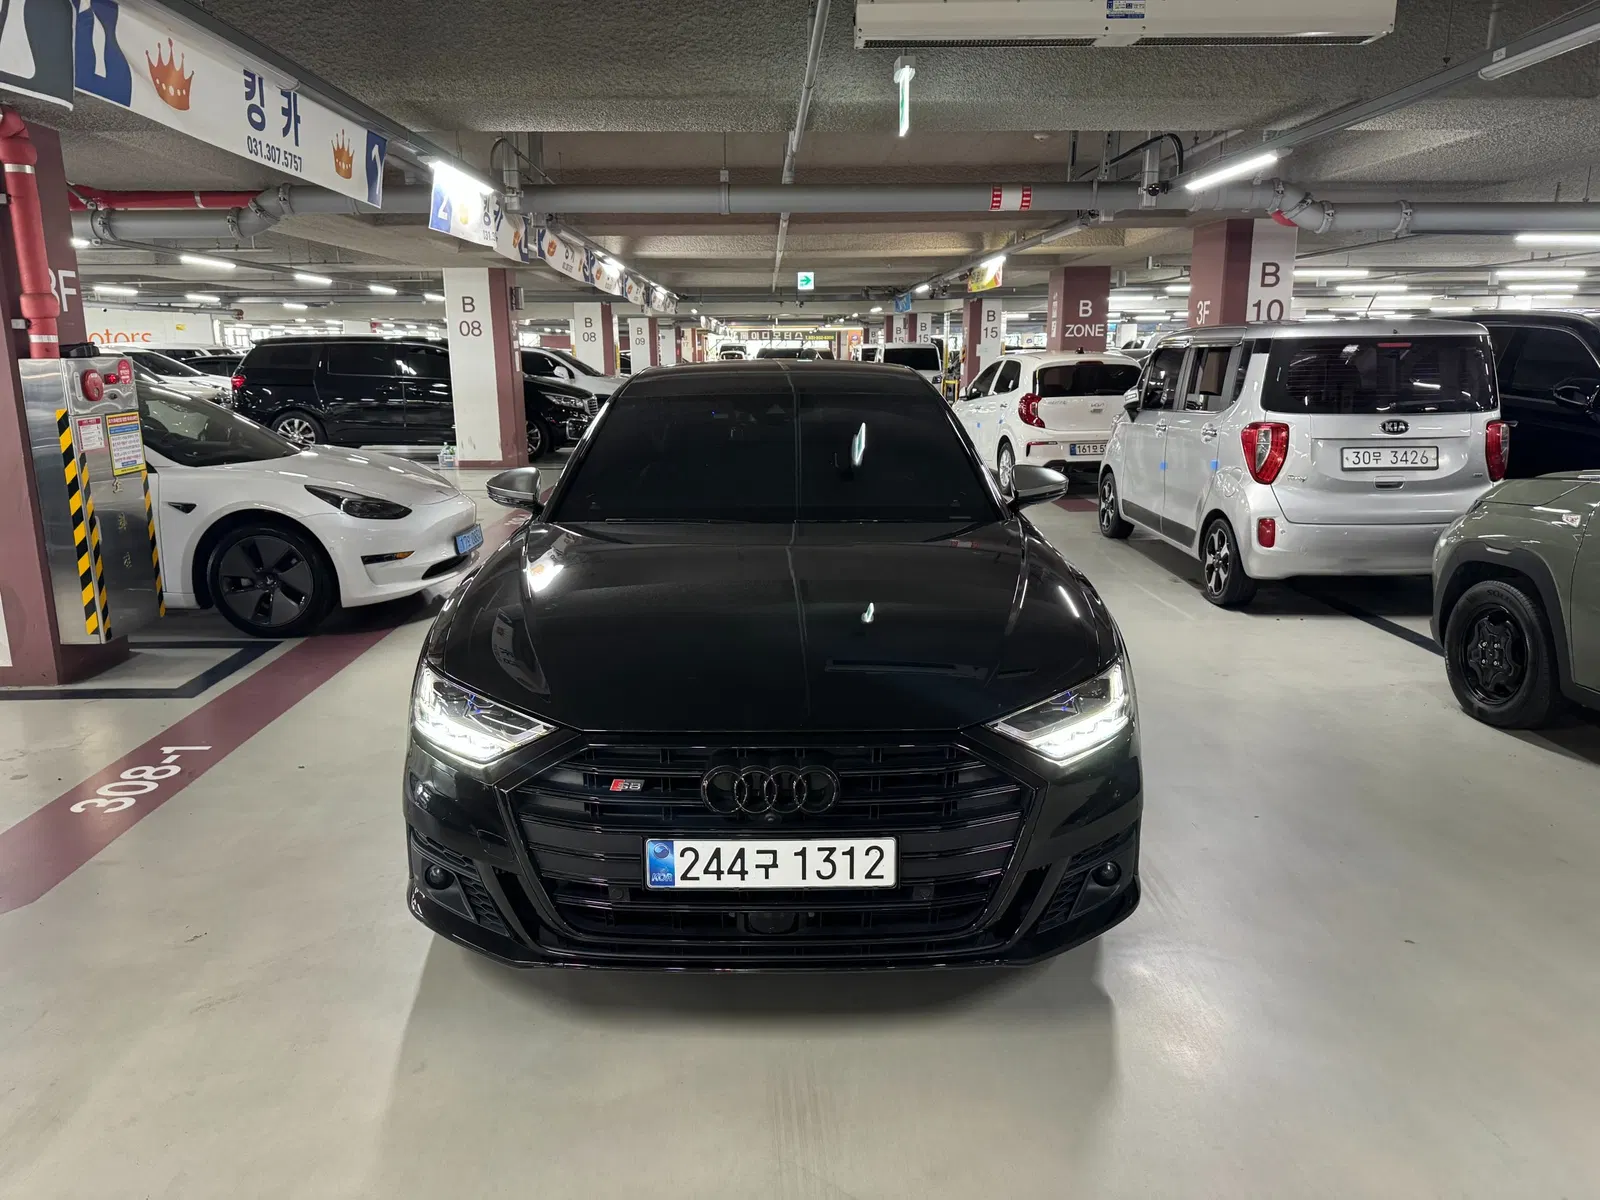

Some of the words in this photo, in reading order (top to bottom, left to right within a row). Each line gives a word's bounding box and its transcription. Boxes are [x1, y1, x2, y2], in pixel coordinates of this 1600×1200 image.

[247, 135, 302, 173] 031.307.5757
[1260, 262, 1281, 288] B
[462, 296, 475, 313] B
[1079, 300, 1092, 317] B
[1252, 299, 1284, 321] 10
[986, 310, 996, 322] B
[1196, 300, 1211, 325] 3F
[459, 320, 482, 337] 08
[584, 317, 593, 328] B
[920, 322, 927, 331] B
[582, 331, 597, 343] 08
[636, 327, 643, 336] B
[983, 326, 998, 339] 15
[1065, 323, 1105, 338] ZONE
[635, 338, 646, 346] 09
[918, 334, 929, 343] 15
[1385, 421, 1406, 432] KIA
[1352, 451, 1382, 465] 30무
[1390, 450, 1429, 465] 3426
[70, 745, 212, 814] 308-1
[679, 847, 779, 881] 244구
[794, 845, 884, 880] 1312
